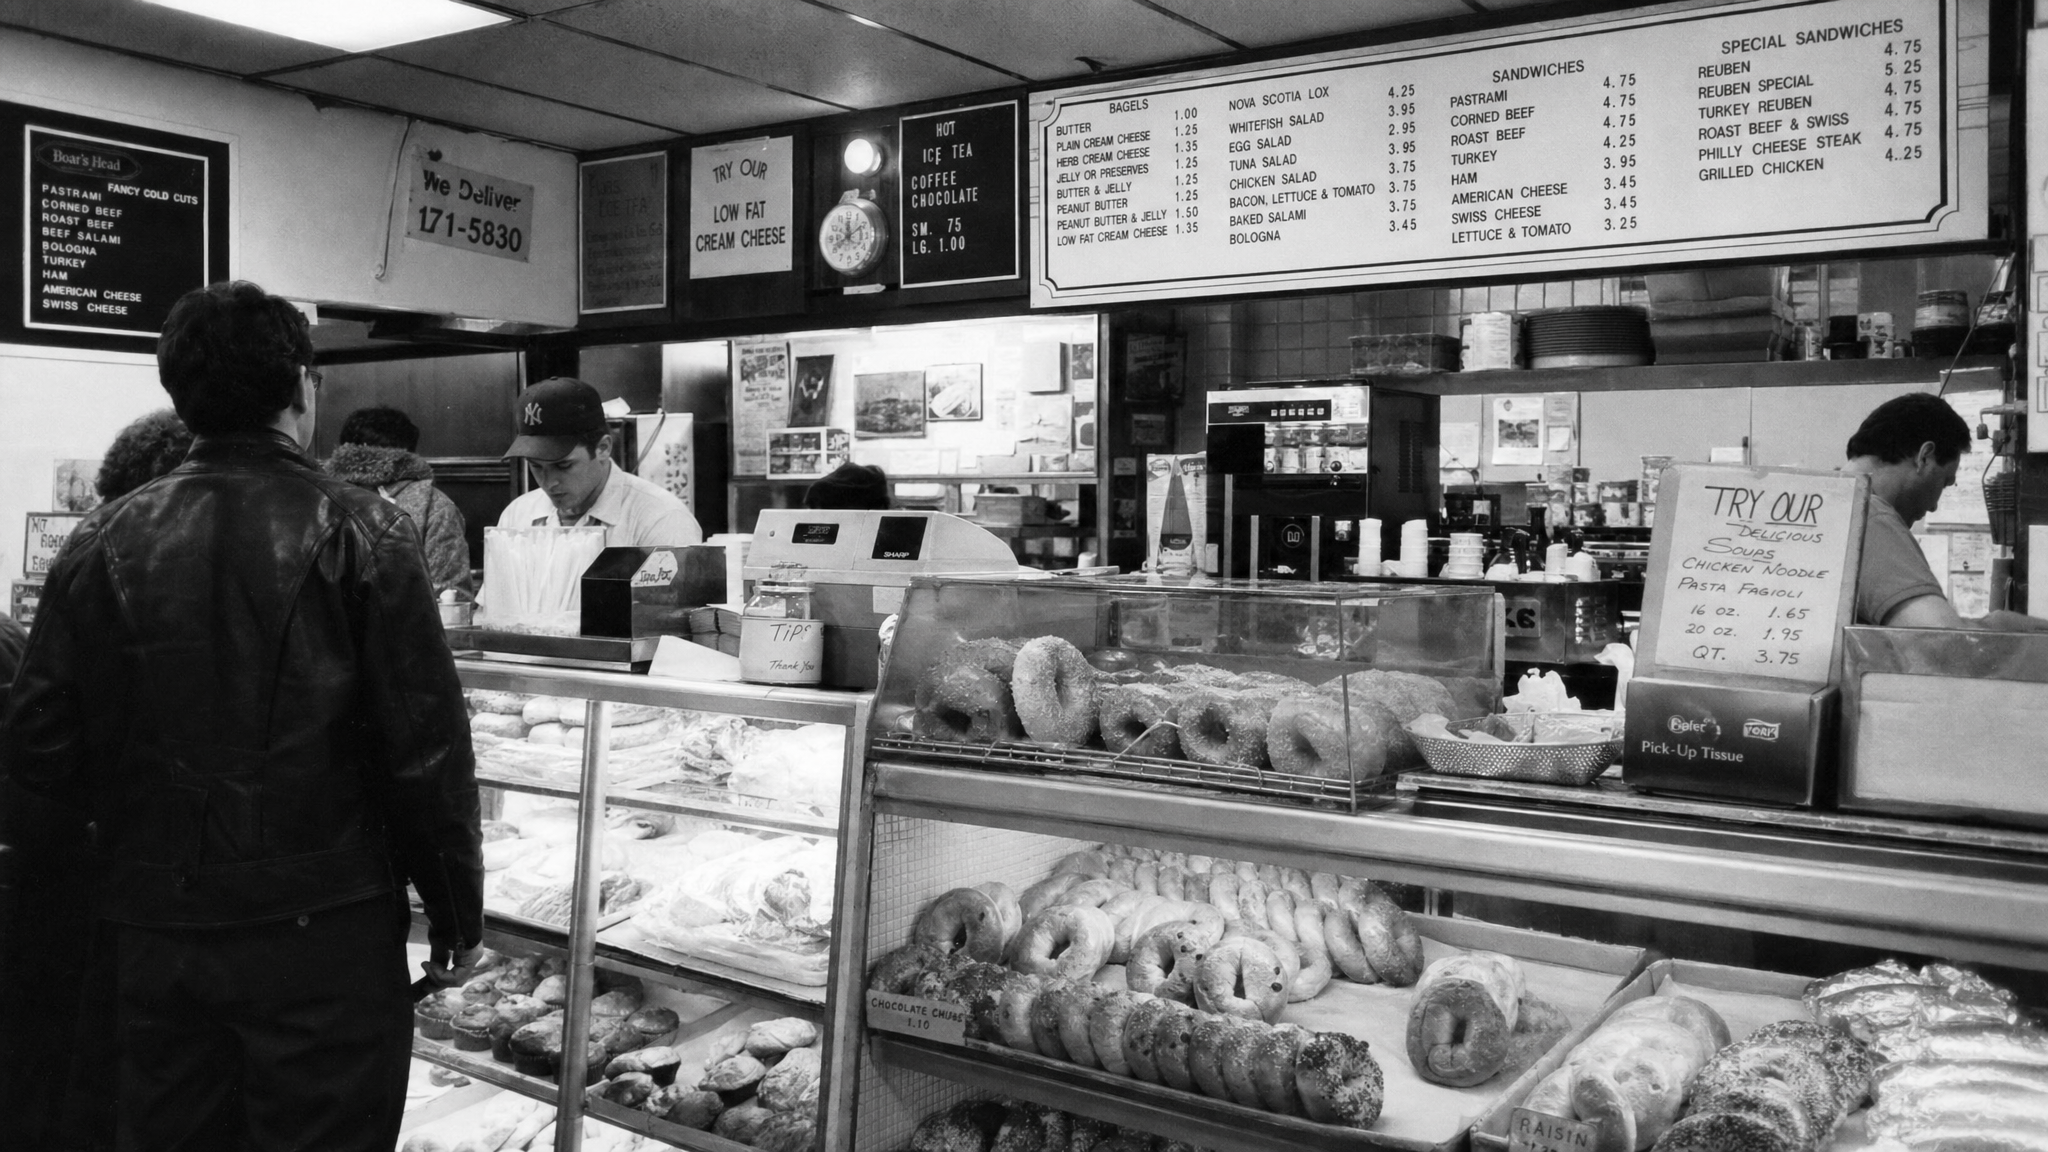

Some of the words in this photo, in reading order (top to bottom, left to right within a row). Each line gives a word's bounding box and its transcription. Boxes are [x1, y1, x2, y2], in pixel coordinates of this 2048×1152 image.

[1722, 35, 1786, 54] SPECIAL
[1796, 19, 1903, 45] SANDWICHES
[1699, 61, 1750, 78] REUBEN
[1884, 39, 1921, 56] 4.75
[1492, 60, 1584, 83] SANDWICHES
[1699, 82, 1750, 99] REUBEN
[1758, 75, 1813, 92] SPECIAL
[1885, 60, 1921, 76] 5.25
[1229, 98, 1256, 111] NOVA
[1262, 91, 1301, 106] SCOTIA
[1308, 86, 1329, 99] LOX
[1388, 84, 1415, 98] 4.25
[1451, 90, 1507, 108] PASTRAMI
[1603, 73, 1636, 88] 4.75
[1699, 103, 1750, 119] TURKEY
[1758, 96, 1812, 113] REUBEN
[1885, 80, 1921, 96] 4.75
[1110, 99, 1148, 114] BAGELS
[1451, 111, 1500, 127] CORNED
[1506, 106, 1535, 120] BEEF
[1603, 94, 1636, 109] 4.75
[936, 121, 955, 137] HOT
[1056, 122, 1091, 136] BUTTER
[1229, 117, 1283, 134] WHITEFISH
[1289, 112, 1324, 127] SALAD
[1388, 103, 1415, 116] 3.95
[1699, 125, 1741, 140] ROAST
[1749, 120, 1782, 135] BEEF
[1807, 113, 1849, 129] SWISS
[1885, 101, 1922, 117] 4.75
[1057, 140, 1080, 152] PLAIN
[1084, 135, 1113, 149] CREAM
[1118, 130, 1150, 144] CHEESE
[1229, 140, 1250, 153] EGG
[1257, 135, 1291, 149] SALAD
[1389, 122, 1415, 135] 2.95
[1451, 132, 1489, 146] ROAST
[1497, 127, 1526, 142] BEEF
[1603, 114, 1636, 128] 4.75
[952, 143, 973, 159] TEA
[1452, 150, 1497, 165] TURKEY
[1603, 134, 1636, 148] 4.25
[1699, 145, 1743, 161] PHILLY
[1752, 138, 1806, 156] CHEESE
[1817, 132, 1861, 149] STEAK
[1885, 122, 1922, 138] 4.75
[53, 149, 89, 166] Boar's
[92, 156, 120, 171] Head
[1057, 156, 1078, 168] HERB
[1083, 152, 1113, 165] CREAM
[1117, 147, 1150, 160] CHEESE
[1229, 158, 1256, 171] TUNA
[1262, 154, 1297, 168] SALAD
[1389, 141, 1415, 155] 3.95
[713, 161, 733, 183] TRY
[740, 158, 767, 180] OUR
[911, 171, 956, 190] COFFEE
[1057, 172, 1080, 183] JELLY
[1100, 163, 1148, 178] PRESERVES
[1230, 175, 1275, 190] CHICKEN
[1282, 171, 1316, 184] SALAD
[1389, 160, 1415, 174] 3.75
[1452, 172, 1477, 186] HAM
[1604, 155, 1636, 169] 3.95
[1699, 165, 1753, 181] GRILLED
[1762, 158, 1824, 175] CHICKEN
[42, 184, 101, 201] PASTRAMI
[108, 183, 140, 196] FANCY
[143, 189, 169, 200] COLD
[174, 194, 198, 204] CUTS
[423, 169, 450, 196] We
[459, 179, 521, 212] Deliver
[911, 187, 978, 208] CHOCOLATE
[1057, 186, 1090, 199] BUTTER
[1105, 182, 1132, 194] JELLY
[1230, 195, 1268, 209] BACON,
[1272, 189, 1317, 205] LETTUCE
[1333, 183, 1375, 198] TOMATO
[1389, 179, 1416, 193] 3.75
[1452, 189, 1513, 205] AMERICAN
[1521, 183, 1568, 198] CHEESE
[1604, 175, 1636, 190] 3.45
[42, 199, 89, 214] CORNED
[96, 206, 122, 218] BEEF
[714, 204, 739, 223] LOW
[746, 201, 766, 219] FAT
[1057, 202, 1090, 214] PEANUT
[1095, 198, 1128, 211] BUTTER
[1230, 213, 1263, 226] BAKED
[1268, 209, 1306, 223] SALAMI
[1389, 199, 1416, 212] 3.75
[1452, 210, 1487, 224] SWISS
[1495, 205, 1541, 221] CHEESE
[1604, 196, 1637, 210] 3.45
[42, 213, 80, 226] ROAST
[87, 219, 114, 229] BEEF
[912, 222, 932, 236] SM.
[948, 218, 961, 232] 75
[1057, 218, 1090, 230] PEANUT
[1094, 214, 1127, 227] BUTTER
[1141, 210, 1167, 222] JELLY
[1452, 228, 1502, 243] LETTUCE
[1522, 222, 1571, 237] TOMATO
[1604, 216, 1637, 231] 3.25
[42, 227, 70, 239] BEEF
[78, 232, 120, 244] SALAMI
[696, 232, 735, 252] CREAM
[741, 226, 786, 248] CHEESE
[1057, 235, 1076, 246] LOW
[1080, 233, 1094, 244] FAT
[1098, 230, 1129, 242] CREAM
[1133, 226, 1168, 238] CHEESE
[1230, 230, 1281, 244] BOLOGNA
[1389, 219, 1416, 232] 3.45
[42, 242, 97, 255] BOLOGNA
[912, 238, 931, 254] LG.
[939, 236, 965, 252] 1.00
[43, 256, 86, 268] TURKEY
[43, 271, 67, 280] HAM
[43, 285, 96, 297] AMERICAN
[104, 291, 142, 302] CHEESE
[43, 300, 78, 310] SWISS
[87, 304, 127, 315] CHEESE
[524, 402, 542, 426] NY
[1705, 486, 1765, 520] TRY
[1770, 491, 1823, 524] OUR
[1731, 522, 1823, 543] DELICIOUS
[1704, 537, 1775, 560] SOUPS
[1682, 557, 1754, 574] CHICKEN
[1763, 564, 1830, 580] NOODLE
[1678, 577, 1726, 593] PASTA
[1738, 582, 1803, 598] FAGIOLI
[1768, 606, 1810, 620] 1.65
[1763, 627, 1803, 641] 1.95
[769, 660, 798, 672] Thank
[1693, 646, 1725, 661] QT.
[1755, 649, 1800, 665] 3.75
[1642, 740, 1697, 758] Pick-Up
[1701, 746, 1744, 763] Tissue
[871, 998, 927, 1015] CHOCOLATE
[908, 1018, 929, 1029] 1.10
[1520, 1118, 1587, 1147] RAISIN
